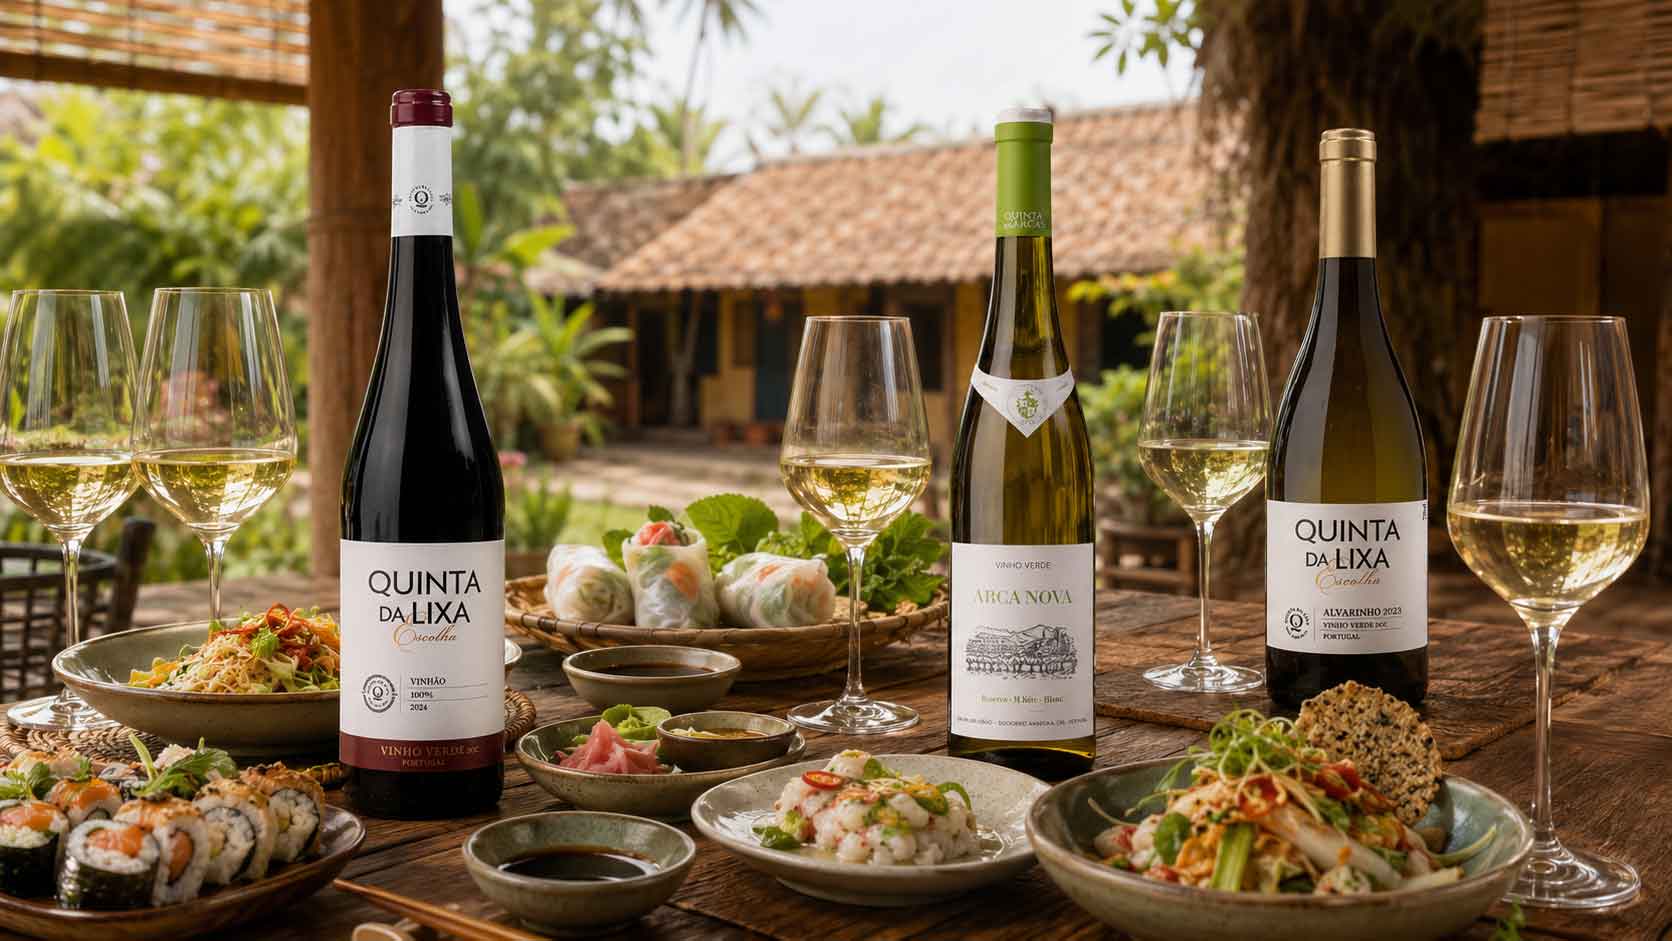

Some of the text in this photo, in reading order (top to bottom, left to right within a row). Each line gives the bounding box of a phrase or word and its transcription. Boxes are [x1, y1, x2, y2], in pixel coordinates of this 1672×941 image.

[1295, 519, 1401, 544] QUINTA
[995, 561, 1052, 569] VINHO VERDE
[1305, 548, 1390, 569] DA LIXA
[368, 570, 481, 597] QUINTA
[975, 590, 1073, 605] ARCA NOVA
[379, 601, 471, 624] DA LIXA
[1323, 607, 1402, 616] ALVARINHO 2023
[393, 612, 457, 648] Escolha
[1322, 621, 1348, 629] VINHO
[1350, 621, 1373, 629] VERDE
[410, 677, 446, 686] VINHÃO
[410, 691, 434, 699] 100%
[380, 745, 421, 758] VINHO
[426, 745, 464, 758] VERDE
[402, 759, 446, 767] PORTUGAL
